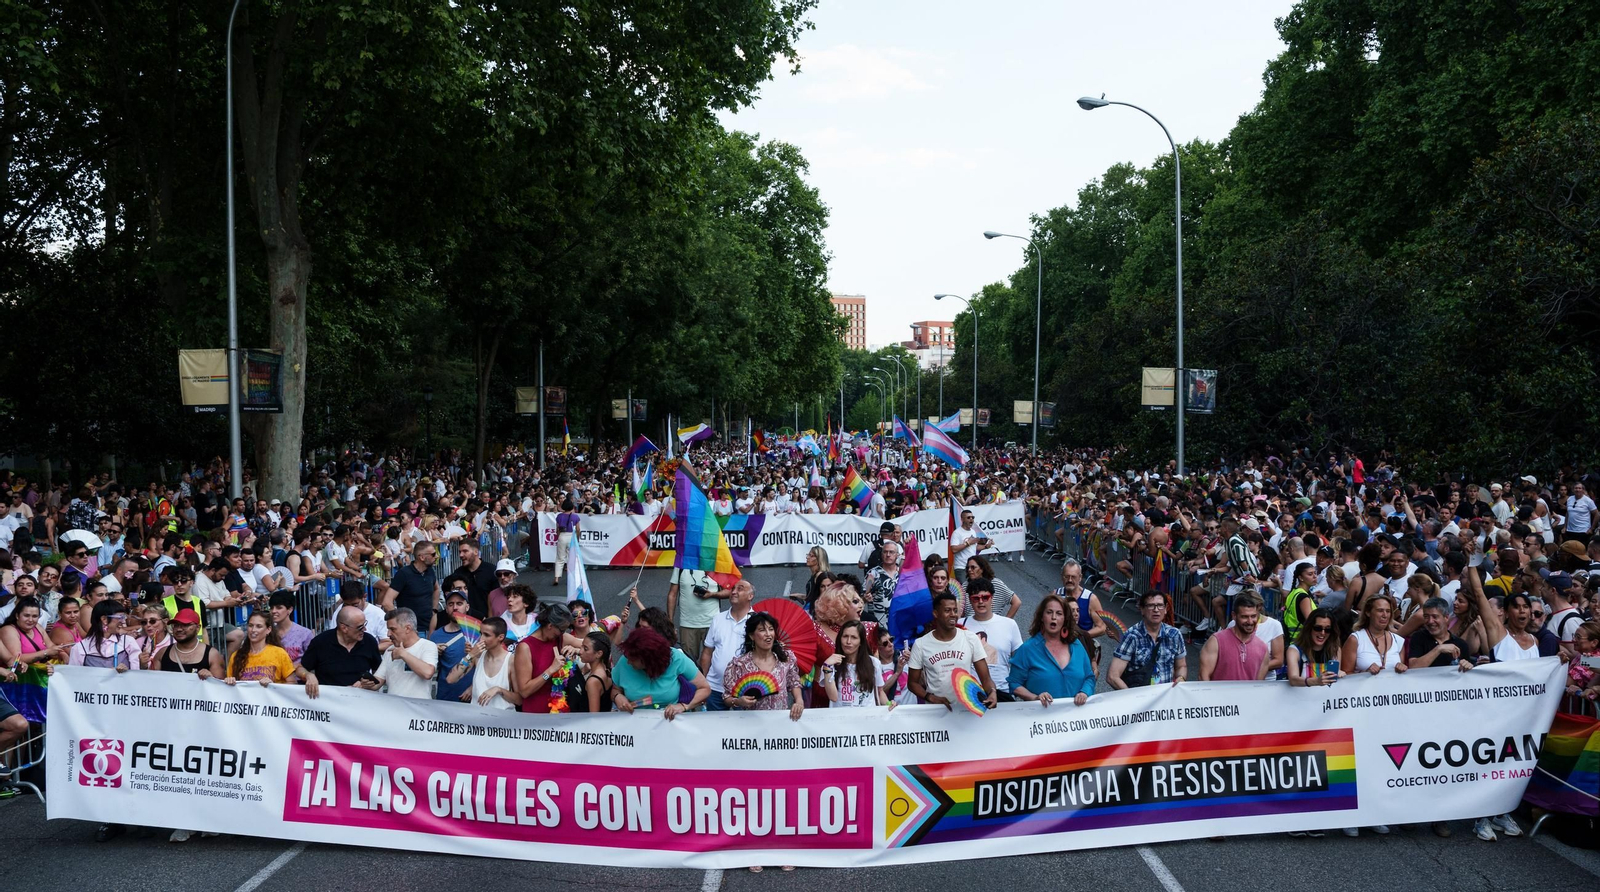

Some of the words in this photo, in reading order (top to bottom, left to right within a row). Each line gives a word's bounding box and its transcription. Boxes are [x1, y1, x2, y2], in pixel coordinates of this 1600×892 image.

[979, 518, 1023, 530] COGAM
[650, 534, 676, 548] PACT
[762, 530, 804, 546] CONTRA
[806, 531, 824, 546] LOS
[929, 526, 948, 544] ¡YA!
[929, 650, 965, 665] DISIDENTE
[74, 691, 95, 704] TAKE
[97, 694, 109, 705] TO
[112, 694, 128, 706] THE
[130, 695, 167, 709] STREETS
[170, 698, 192, 710] WITH
[194, 699, 222, 713] PRIDE!
[224, 702, 260, 716] DISSENT
[261, 706, 279, 718] AND
[281, 706, 330, 723] RESISTANCE
[1322, 699, 1331, 713] ¡A
[1334, 697, 1348, 709] LES
[1350, 696, 1370, 708] CAIS
[1373, 695, 1390, 707] CON
[1392, 692, 1433, 705] ORGULLU!
[1435, 688, 1483, 702] DISIDENCIA
[1484, 688, 1490, 698] Y
[1492, 684, 1546, 698] RESISTENCIA
[1029, 722, 1044, 738] ¡ÁS
[1046, 720, 1068, 734] RÚAS
[1070, 719, 1088, 732] CON
[1089, 713, 1130, 729] ORGULLO!
[1130, 708, 1175, 724] DISIDENCIA
[1178, 708, 1182, 720] E
[1185, 705, 1240, 719] RESISTENCIA
[408, 719, 425, 731] ALS
[427, 721, 465, 735] CARRERS
[466, 725, 485, 736] AMB
[488, 726, 521, 739] ORGULL!
[524, 728, 573, 743] DISSIDÈNCIA
[575, 733, 578, 744] I
[580, 732, 634, 747] RESISTÈNCIA
[722, 738, 761, 751] KALERA,
[764, 737, 798, 750] HARRO!
[801, 735, 858, 749] DISIDENTZIA
[860, 734, 876, 746] ETA
[879, 730, 950, 746] ERRESISTENTZIA
[131, 741, 266, 778] FELGTBI+
[130, 772, 169, 783] Federación
[172, 775, 196, 784] Estatal
[207, 779, 243, 791] Lesbianas,
[245, 783, 264, 793] Gais,
[978, 770, 1121, 816] DISIDENCIA
[1128, 767, 1143, 800] Y
[1152, 754, 1322, 798] RESISTENCIA
[1387, 775, 1448, 788] COLECTIVO
[1451, 772, 1479, 783] LGTBI
[1491, 770, 1505, 780] DE
[1508, 768, 1534, 778] MAD
[130, 781, 150, 791] Trans,
[153, 783, 192, 796] Bisexuales,
[194, 787, 239, 799] Intersexuales
[247, 793, 263, 801] más
[299, 759, 336, 807] ¡A
[350, 761, 416, 814] LAS
[427, 770, 560, 828] CALLES
[574, 782, 652, 832] CON
[666, 785, 858, 836] ORGULLO!
